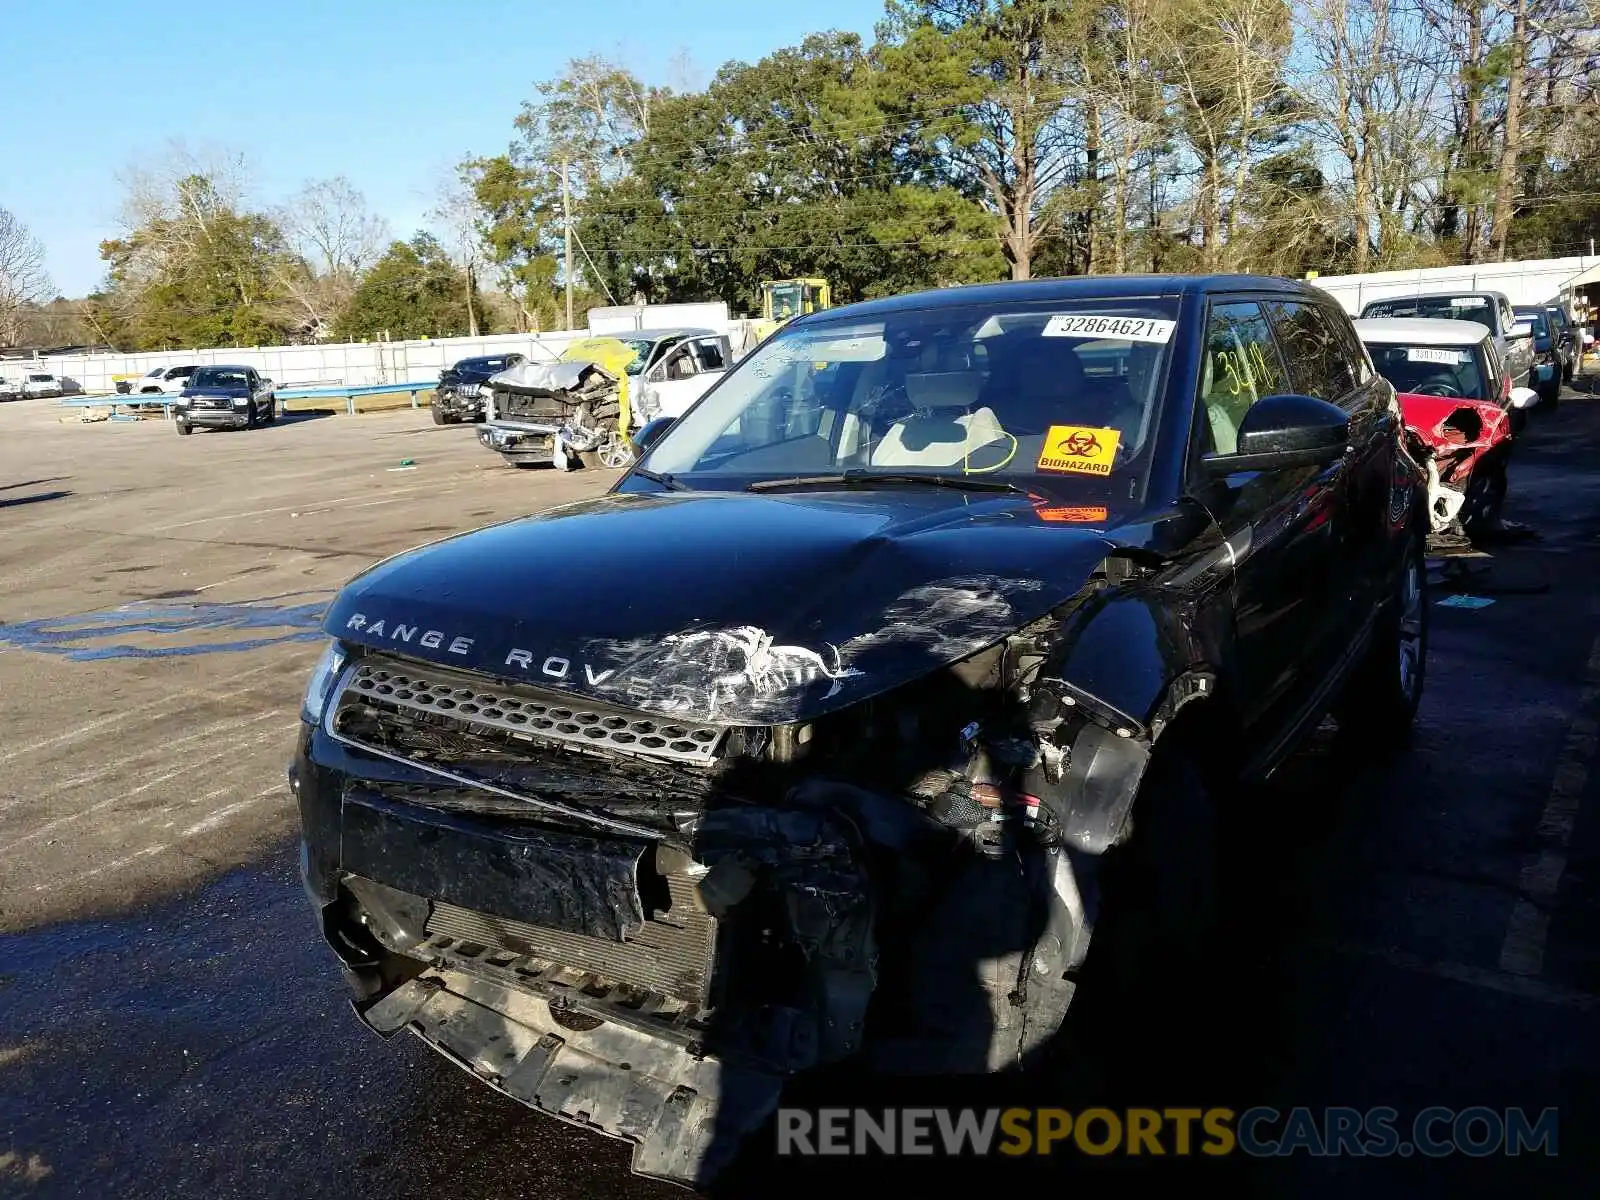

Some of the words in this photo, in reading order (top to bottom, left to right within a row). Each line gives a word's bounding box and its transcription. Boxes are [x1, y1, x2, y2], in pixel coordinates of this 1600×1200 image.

[1060, 317, 1156, 337] 32864621
[1040, 457, 1110, 473] BIOHAZARD
[346, 613, 474, 655] RANGE
